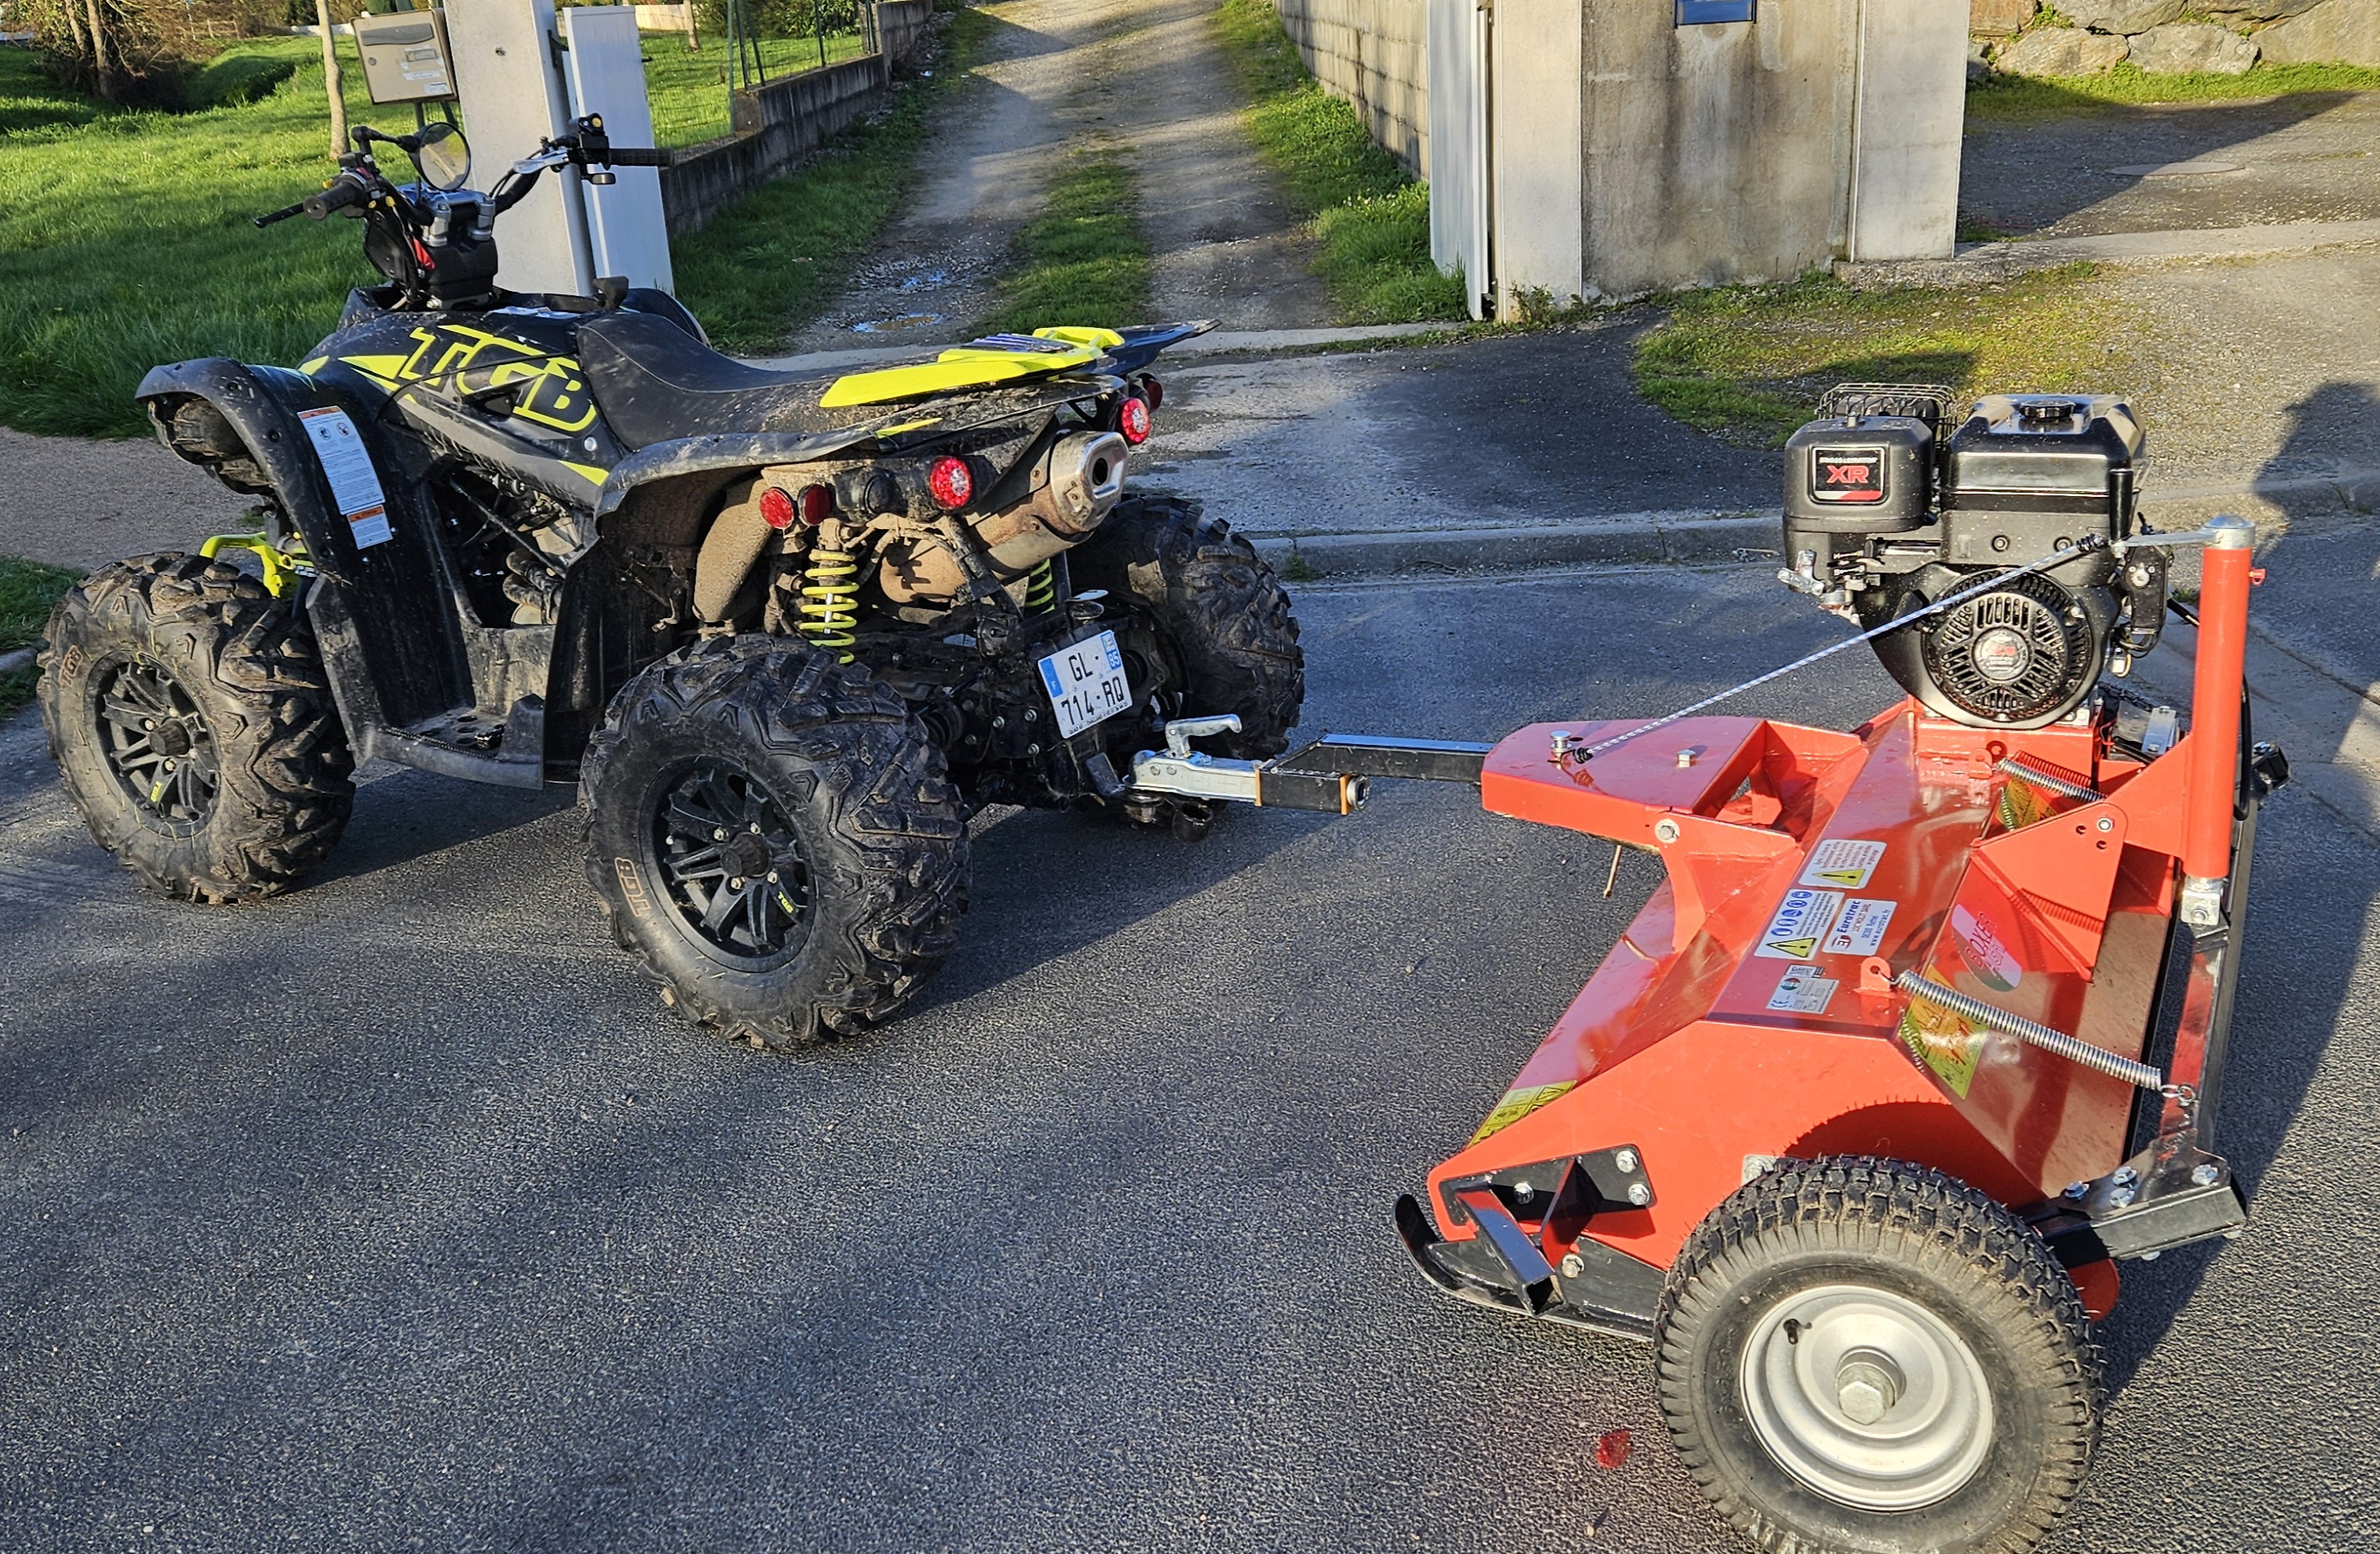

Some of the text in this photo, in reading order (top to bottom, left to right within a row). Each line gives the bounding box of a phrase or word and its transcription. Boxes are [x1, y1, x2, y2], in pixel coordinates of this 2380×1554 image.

[399, 325, 596, 431] TGB
[1827, 466, 1869, 484] XR
[1108, 651, 1120, 668] 85
[615, 857, 652, 917] TGB
[1836, 900, 1861, 933] Eurotrac
[1965, 911, 1997, 970] BOXER
